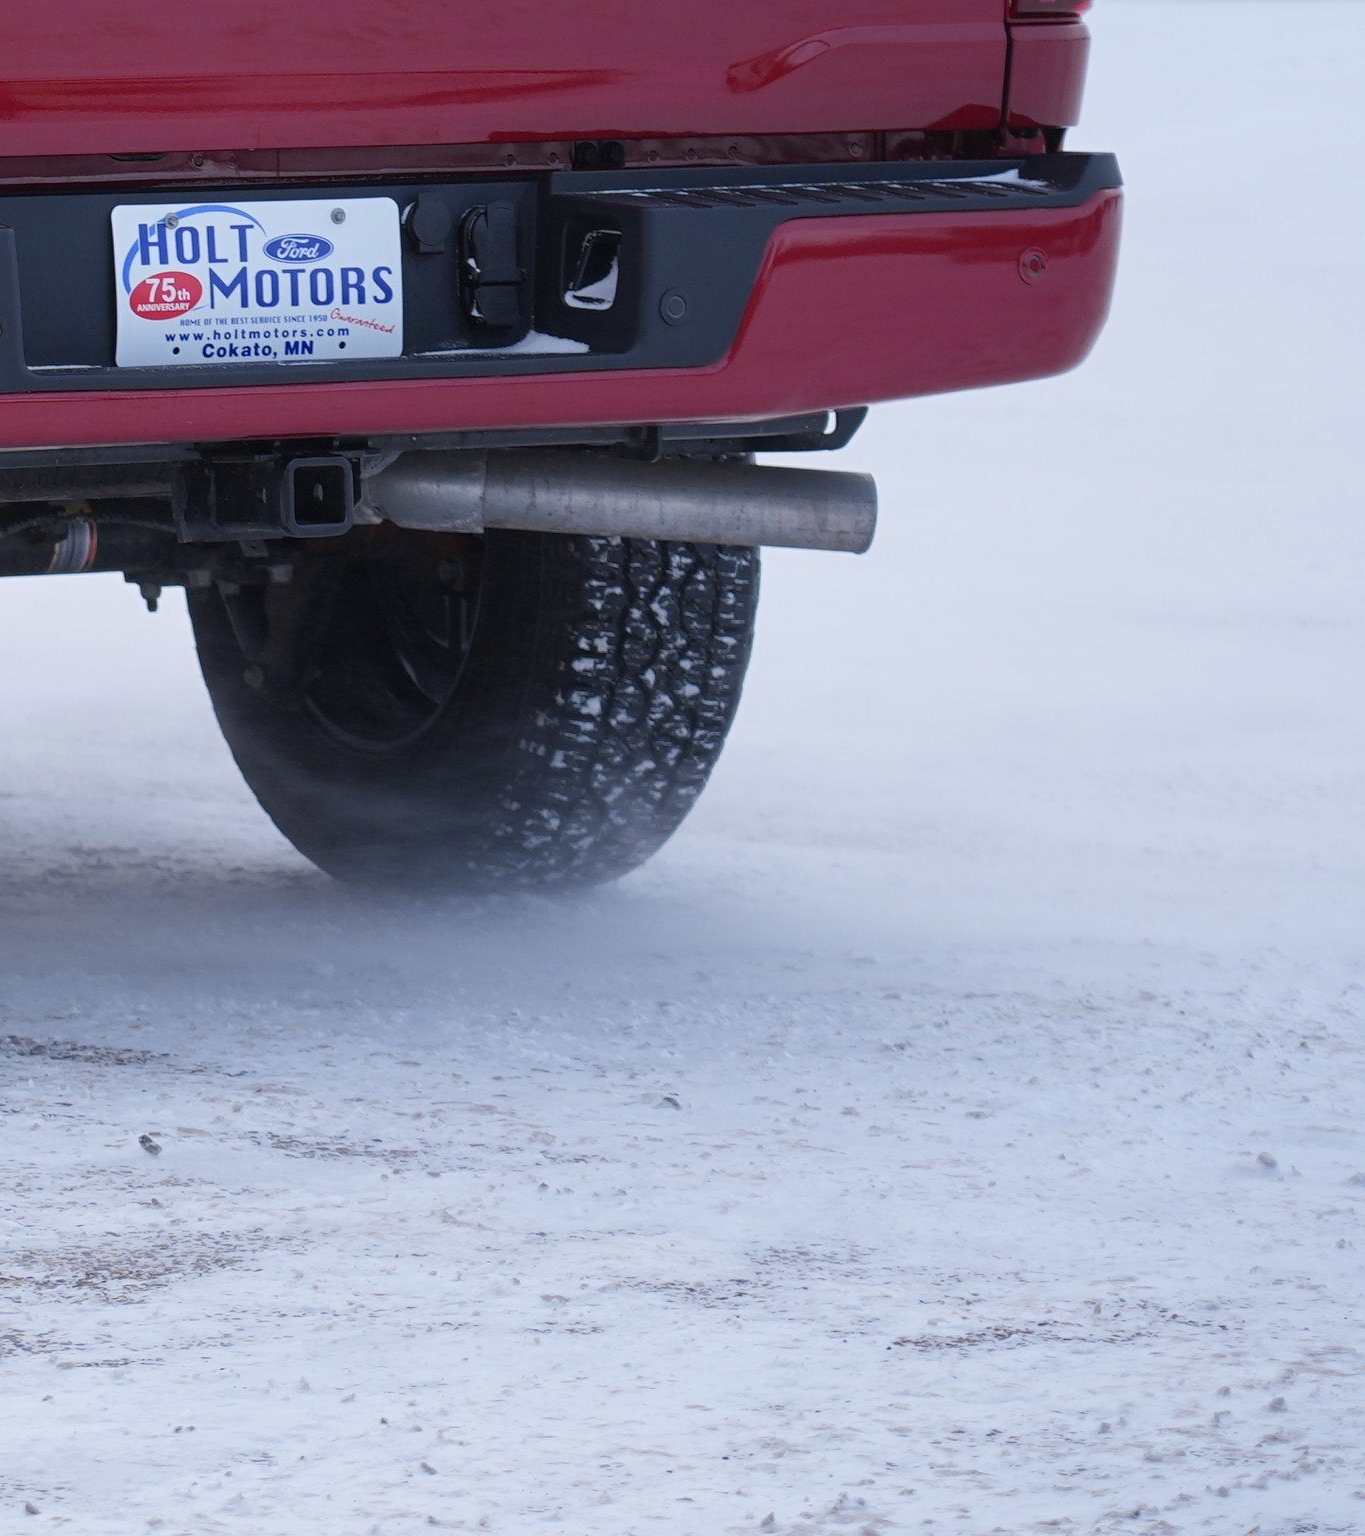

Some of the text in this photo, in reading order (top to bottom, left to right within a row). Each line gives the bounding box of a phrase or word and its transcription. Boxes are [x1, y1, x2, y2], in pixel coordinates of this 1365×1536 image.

[138, 222, 254, 266] HOLT
[145, 278, 191, 302] 75th
[208, 266, 394, 310] MOTORS
[136, 302, 191, 313] ANNIVERSARY
[180, 319, 202, 327] HOME
[204, 318, 213, 326] OF
[215, 318, 229, 326] THE
[231, 317, 248, 325] BEST
[284, 315, 305, 324] SINCE
[309, 314, 328, 323] 1950
[330, 307, 396, 334] Guaranteed
[165, 327, 350, 342] www.holtmotors.com
[202, 340, 314, 360] Cokato, MN
